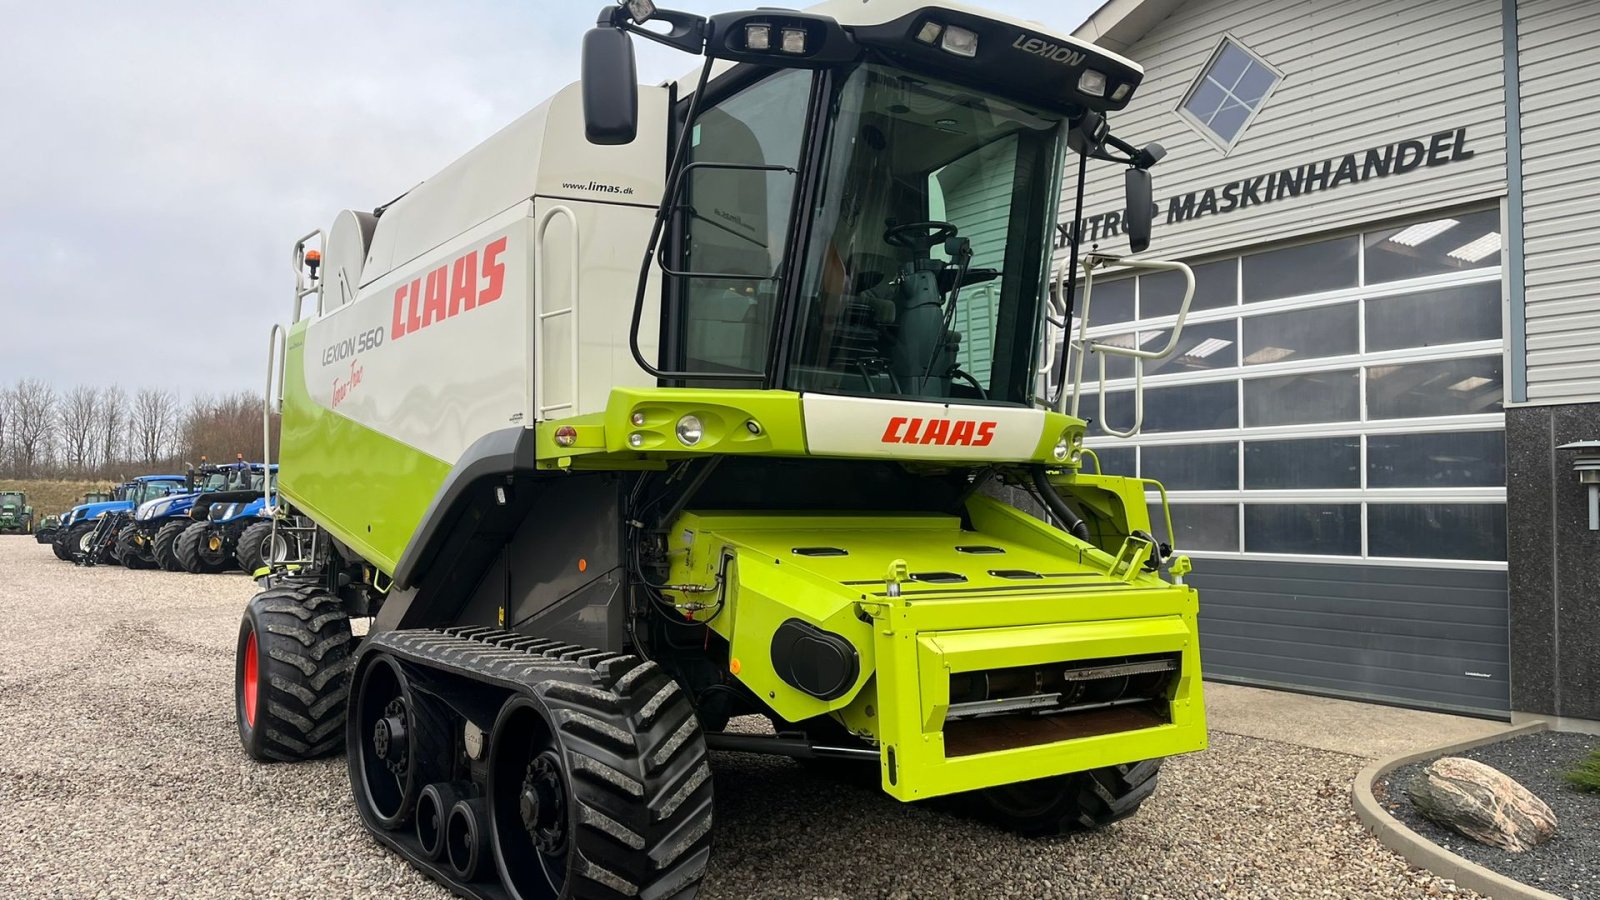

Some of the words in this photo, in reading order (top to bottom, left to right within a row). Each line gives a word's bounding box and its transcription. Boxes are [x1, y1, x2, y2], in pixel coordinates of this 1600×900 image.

[1012, 34, 1086, 66] LEXION
[562, 181, 634, 195] www.limas.dk
[1166, 127, 1475, 225] MASKINHANDEL
[391, 236, 507, 341] CLAAS
[321, 335, 356, 367] LEXION
[357, 326, 384, 354] 560
[881, 416, 998, 447] CLAAS
